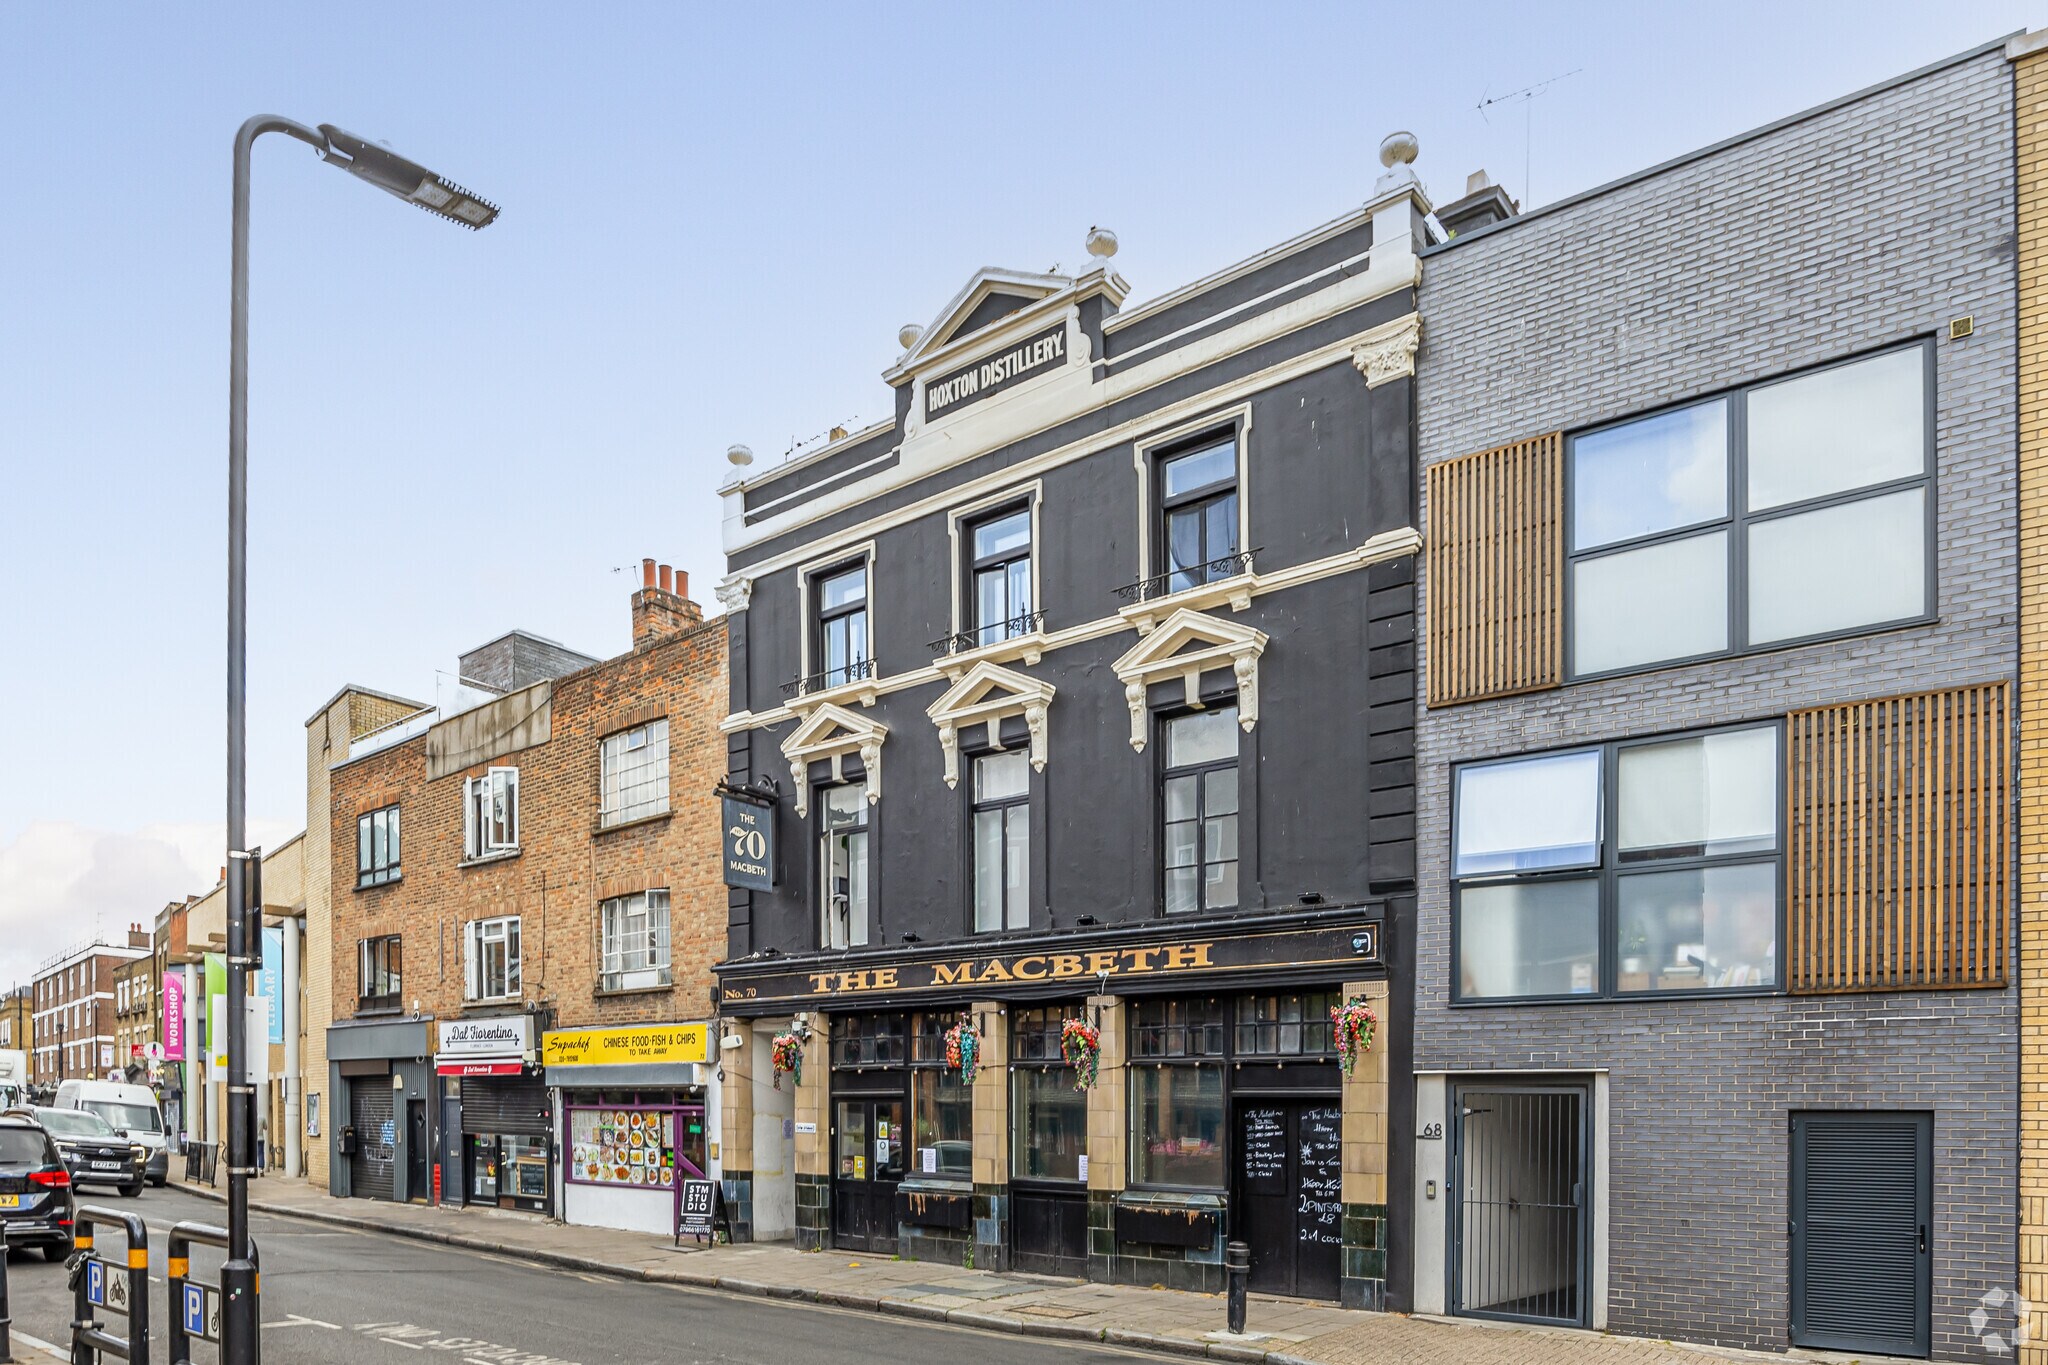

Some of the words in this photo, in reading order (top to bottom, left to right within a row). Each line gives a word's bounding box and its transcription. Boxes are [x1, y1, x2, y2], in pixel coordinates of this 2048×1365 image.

[929, 368, 979, 413] HOXTON
[739, 812, 755, 825] THE
[729, 825, 766, 860] 70
[730, 860, 767, 877] MACBETH
[809, 968, 899, 993] THE
[930, 943, 1213, 985] MACBETH
[264, 967, 276, 1027] LIBRARY
[724, 989, 743, 999] No.
[746, 987, 757, 998] 70
[169, 987, 179, 1047] WORKSHOP
[451, 1026, 468, 1040] Dal
[470, 1023, 513, 1040] Fiorentino
[603, 1037, 629, 1048] CHINESE
[669, 1034, 673, 1044] &
[676, 1032, 696, 1045] CHIPS
[547, 1036, 591, 1054] Supachef
[629, 1048, 636, 1056] TO
[638, 1047, 651, 1056] TAKE
[653, 1047, 668, 1055] AWAY
[1424, 1122, 1442, 1136] 68
[688, 1194, 707, 1202] STU
[689, 1185, 709, 1194] STM
[687, 1202, 707, 1211] DIO
[91, 1265, 101, 1300] P
[188, 1289, 201, 1329] P
